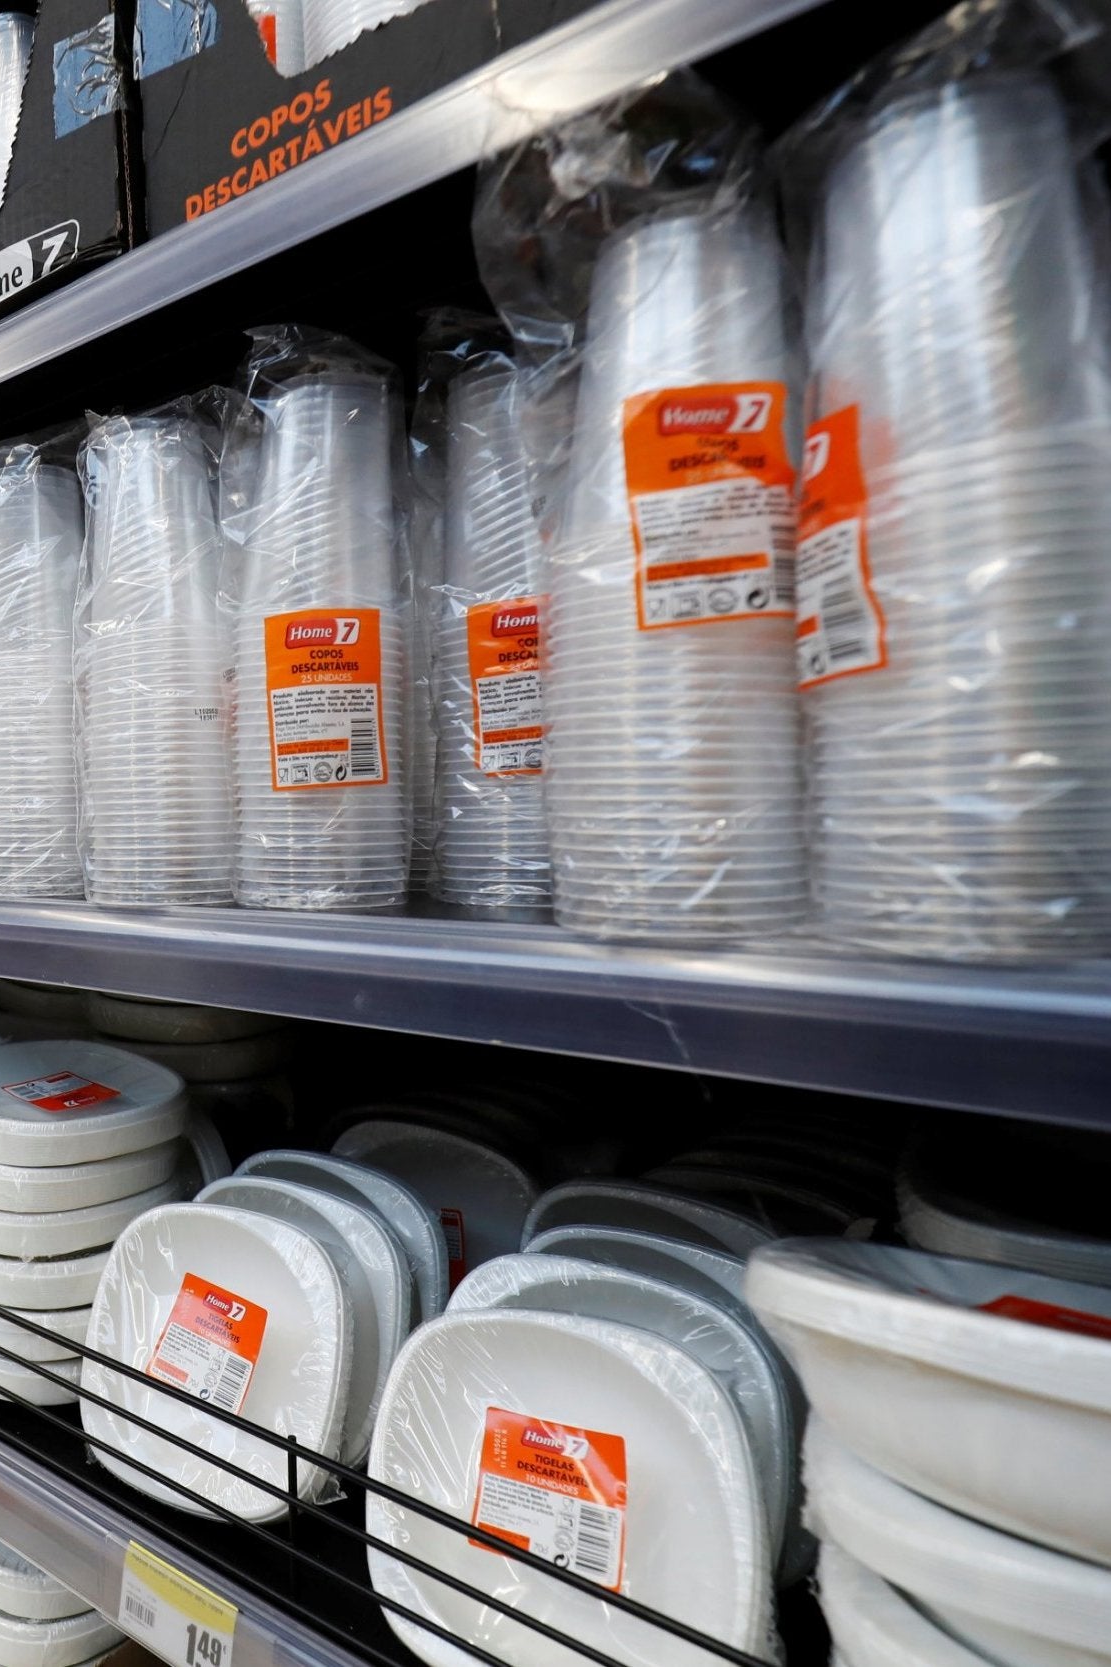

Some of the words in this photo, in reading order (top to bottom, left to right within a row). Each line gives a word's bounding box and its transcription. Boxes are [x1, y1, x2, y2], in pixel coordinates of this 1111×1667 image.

[230, 78, 332, 158] COPOS
[185, 86, 393, 222] DESCARTÁVEIS
[41, 231, 69, 277] 7
[662, 405, 730, 427] Home
[743, 400, 765, 429] 7
[290, 626, 333, 641] Home
[341, 621, 356, 642] 7
[496, 614, 538, 629] Hom
[310, 649, 344, 659] COPOS
[291, 660, 360, 674] DESCARTÁVEIS
[301, 674, 312, 684] 25
[314, 672, 353, 682] UNIDADES
[206, 1293, 230, 1312] Home
[232, 1305, 244, 1318] 7
[525, 1430, 562, 1449] Home
[569, 1439, 585, 1456] 7
[534, 1453, 575, 1472] TIGELAS
[525, 1473, 536, 1483] 10
[536, 1476, 579, 1495] UNIDADES
